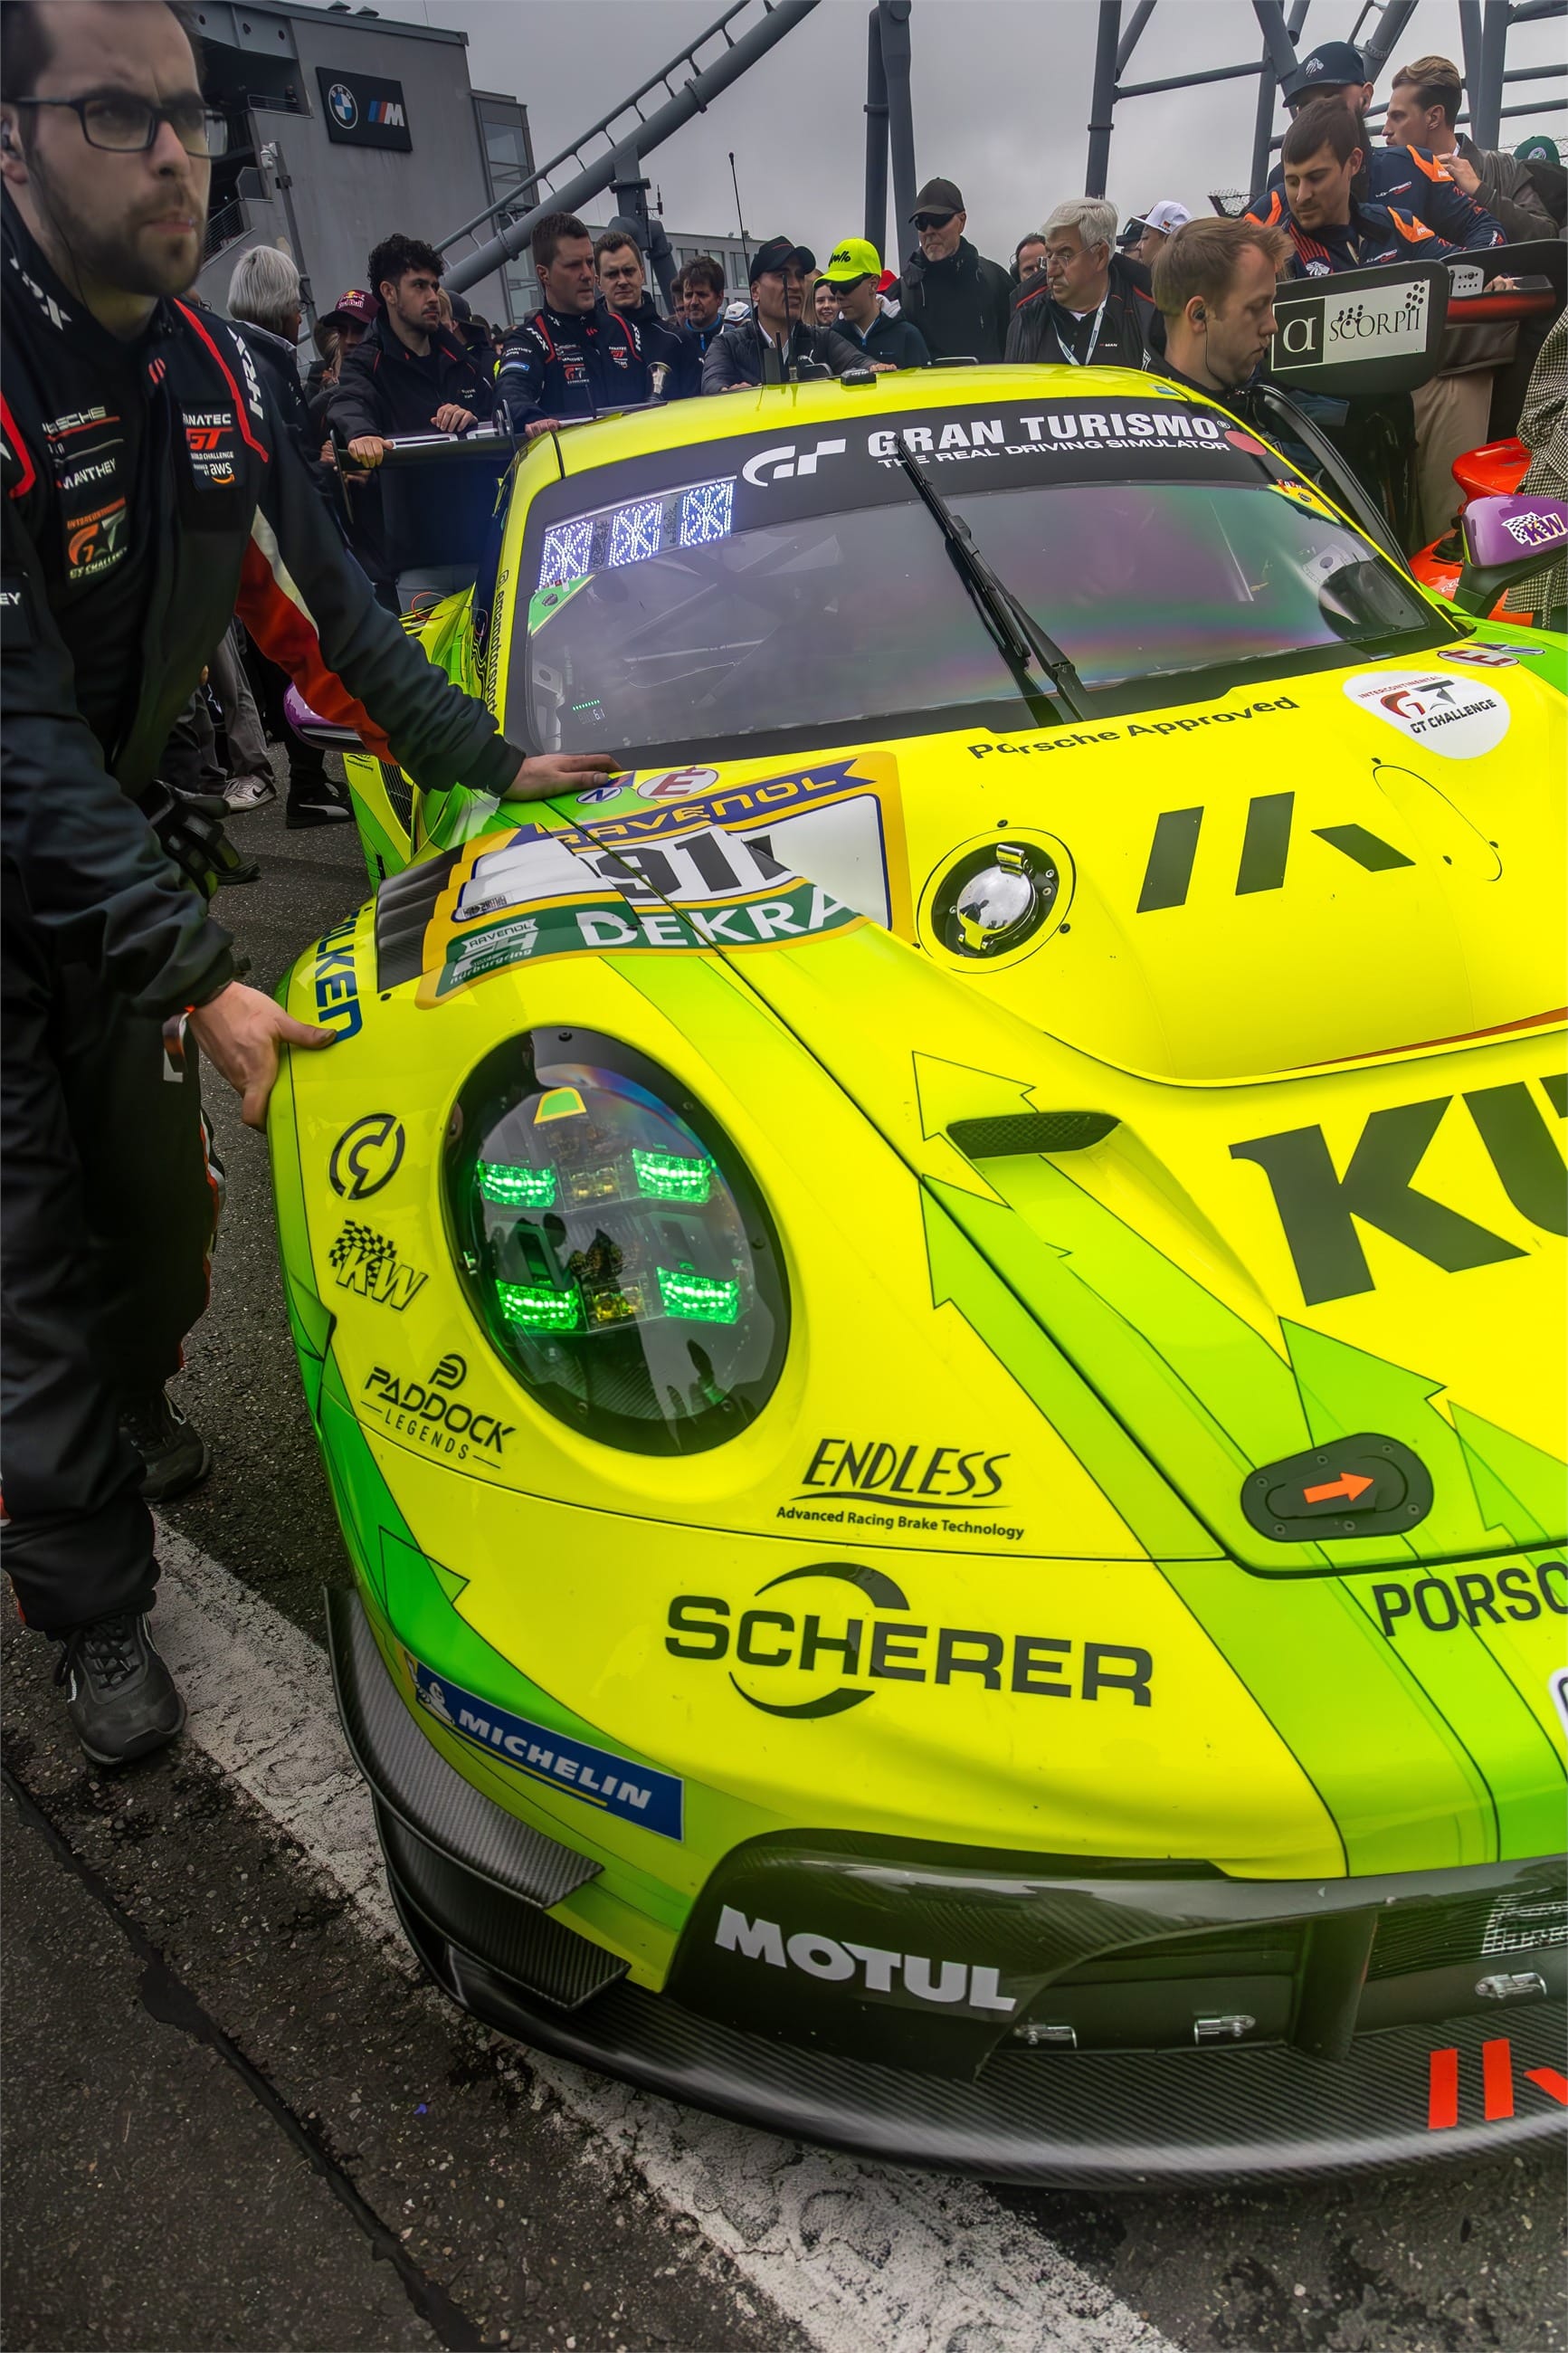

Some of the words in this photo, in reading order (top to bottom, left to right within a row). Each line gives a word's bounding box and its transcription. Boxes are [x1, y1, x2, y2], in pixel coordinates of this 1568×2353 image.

[1329, 308, 1421, 342] SCORPII
[868, 419, 1005, 457] GRAN
[935, 447, 1000, 462] REAL
[1004, 439, 1105, 456] DRIVING
[1106, 438, 1231, 452] SIMULATOR
[210, 462, 233, 476] aws
[1357, 675, 1442, 700] INTERCONTINENTAL
[966, 732, 1121, 759] Porsche
[1126, 696, 1302, 738] Approved
[1410, 720, 1427, 734] GT
[1427, 699, 1497, 729] CHALLENGE
[554, 777, 837, 845] RAVENOL
[469, 921, 532, 948] RAVENOL
[575, 884, 842, 947] DEKRA
[336, 1243, 429, 1312] KW
[365, 1367, 517, 1453] PADDOCK
[385, 1408, 470, 1460] LEGENDS
[803, 1438, 1012, 1498] ENDLESS
[776, 1506, 844, 1522] Advanced
[848, 1512, 894, 1529] Racing
[898, 1516, 938, 1530] Brake
[941, 1519, 1025, 1539] Technology
[665, 1595, 1155, 1707] SCHERER
[458, 1708, 652, 1810] MICHELIN
[715, 1903, 1017, 2012] MOTUL
